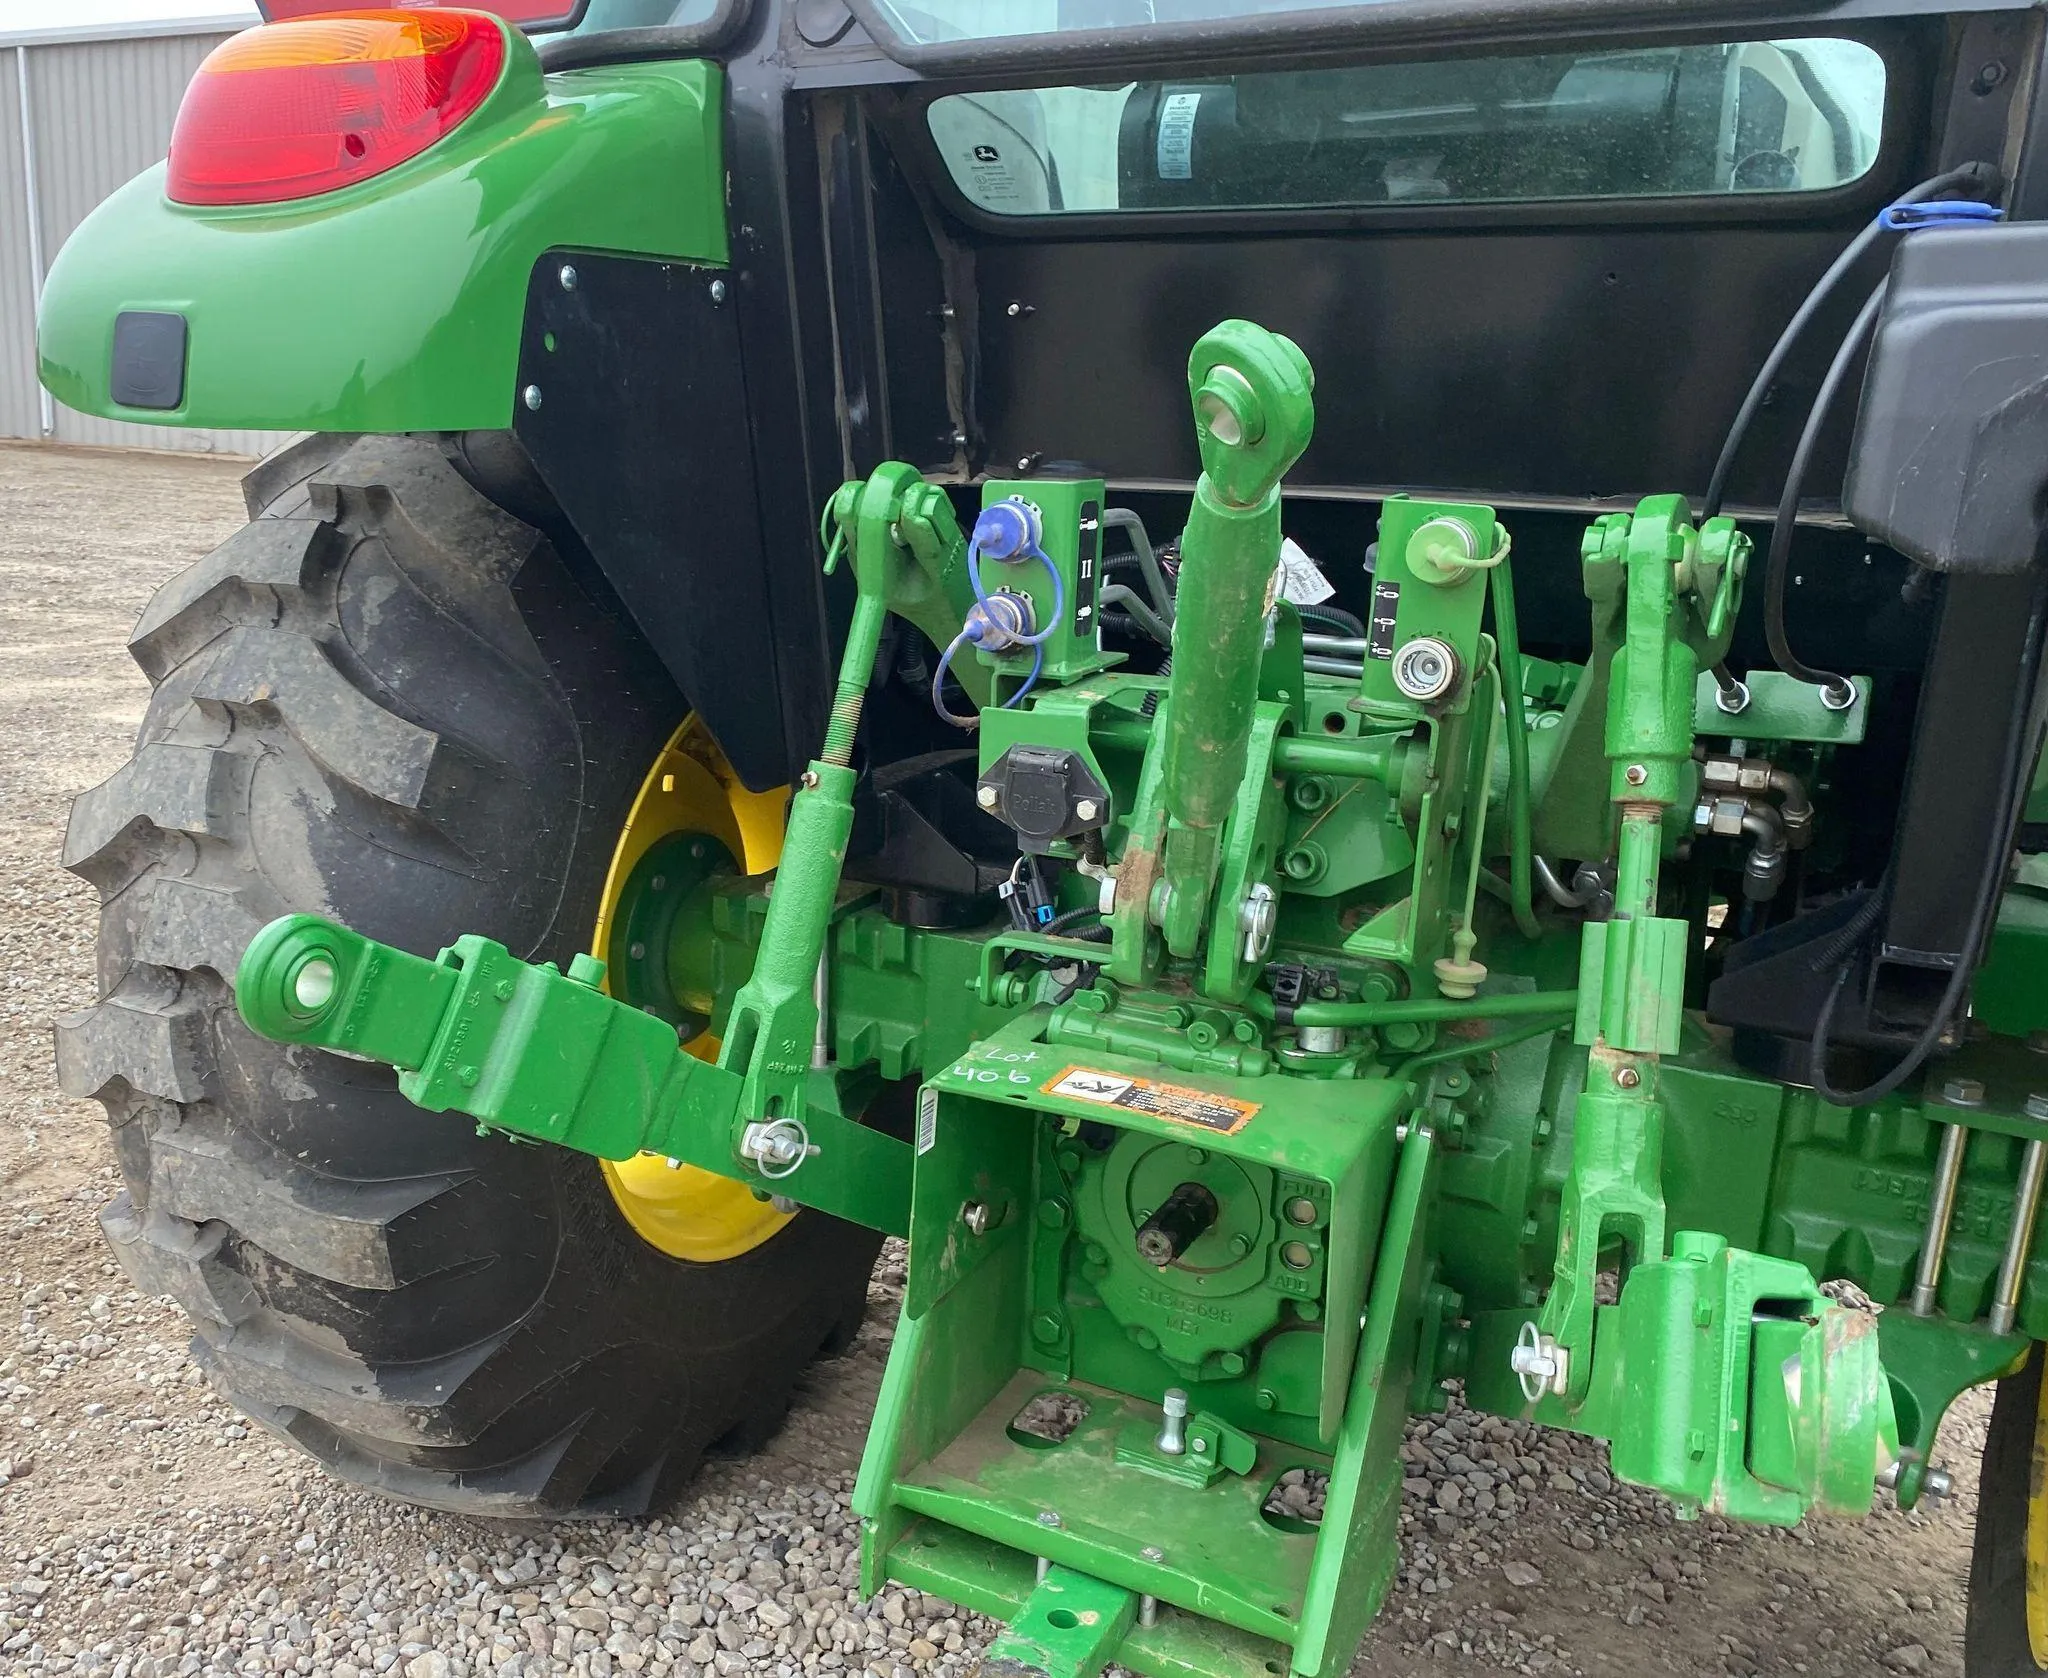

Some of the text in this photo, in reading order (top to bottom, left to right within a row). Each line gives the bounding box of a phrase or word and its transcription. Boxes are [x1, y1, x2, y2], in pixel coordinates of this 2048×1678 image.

[984, 1048, 1041, 1062] Lot
[953, 1065, 1032, 1084] 406
[1283, 1180, 1329, 1200] FULL
[1274, 1274, 1310, 1293] ADD
